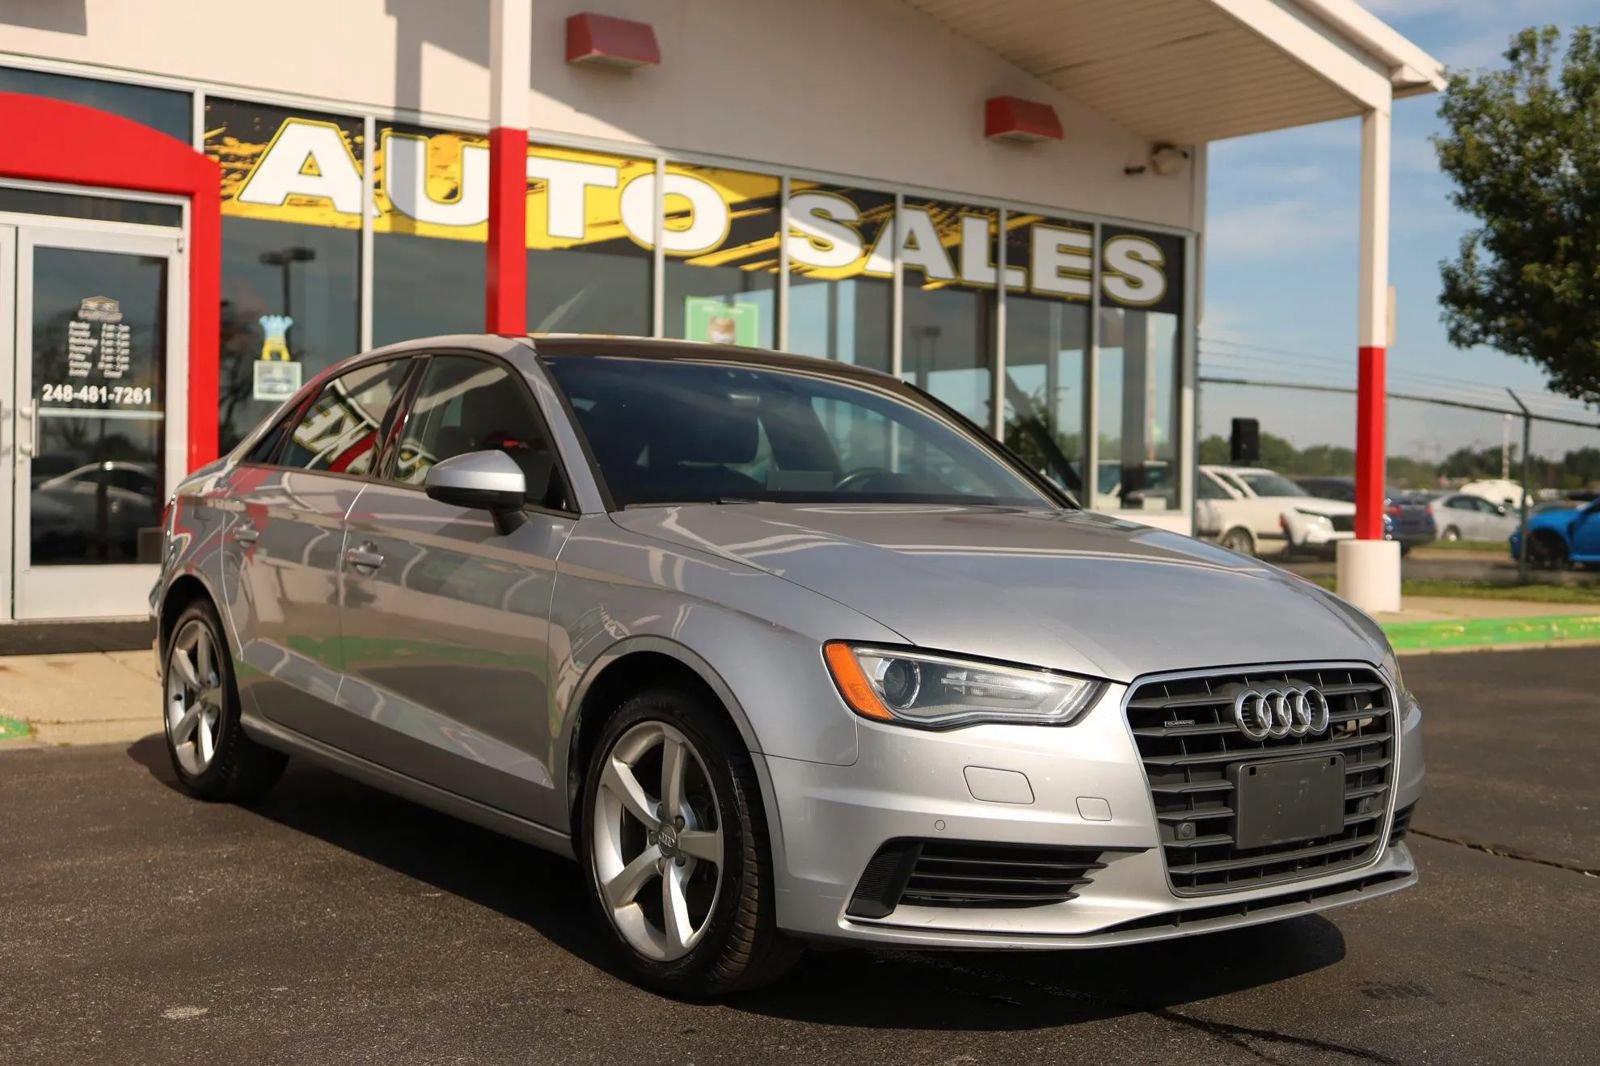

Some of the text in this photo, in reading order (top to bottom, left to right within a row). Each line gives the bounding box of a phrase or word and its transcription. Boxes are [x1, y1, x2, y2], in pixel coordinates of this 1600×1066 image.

[237, 117, 1168, 306] AUTO SALES
[42, 384, 152, 404] 248-481-7261
